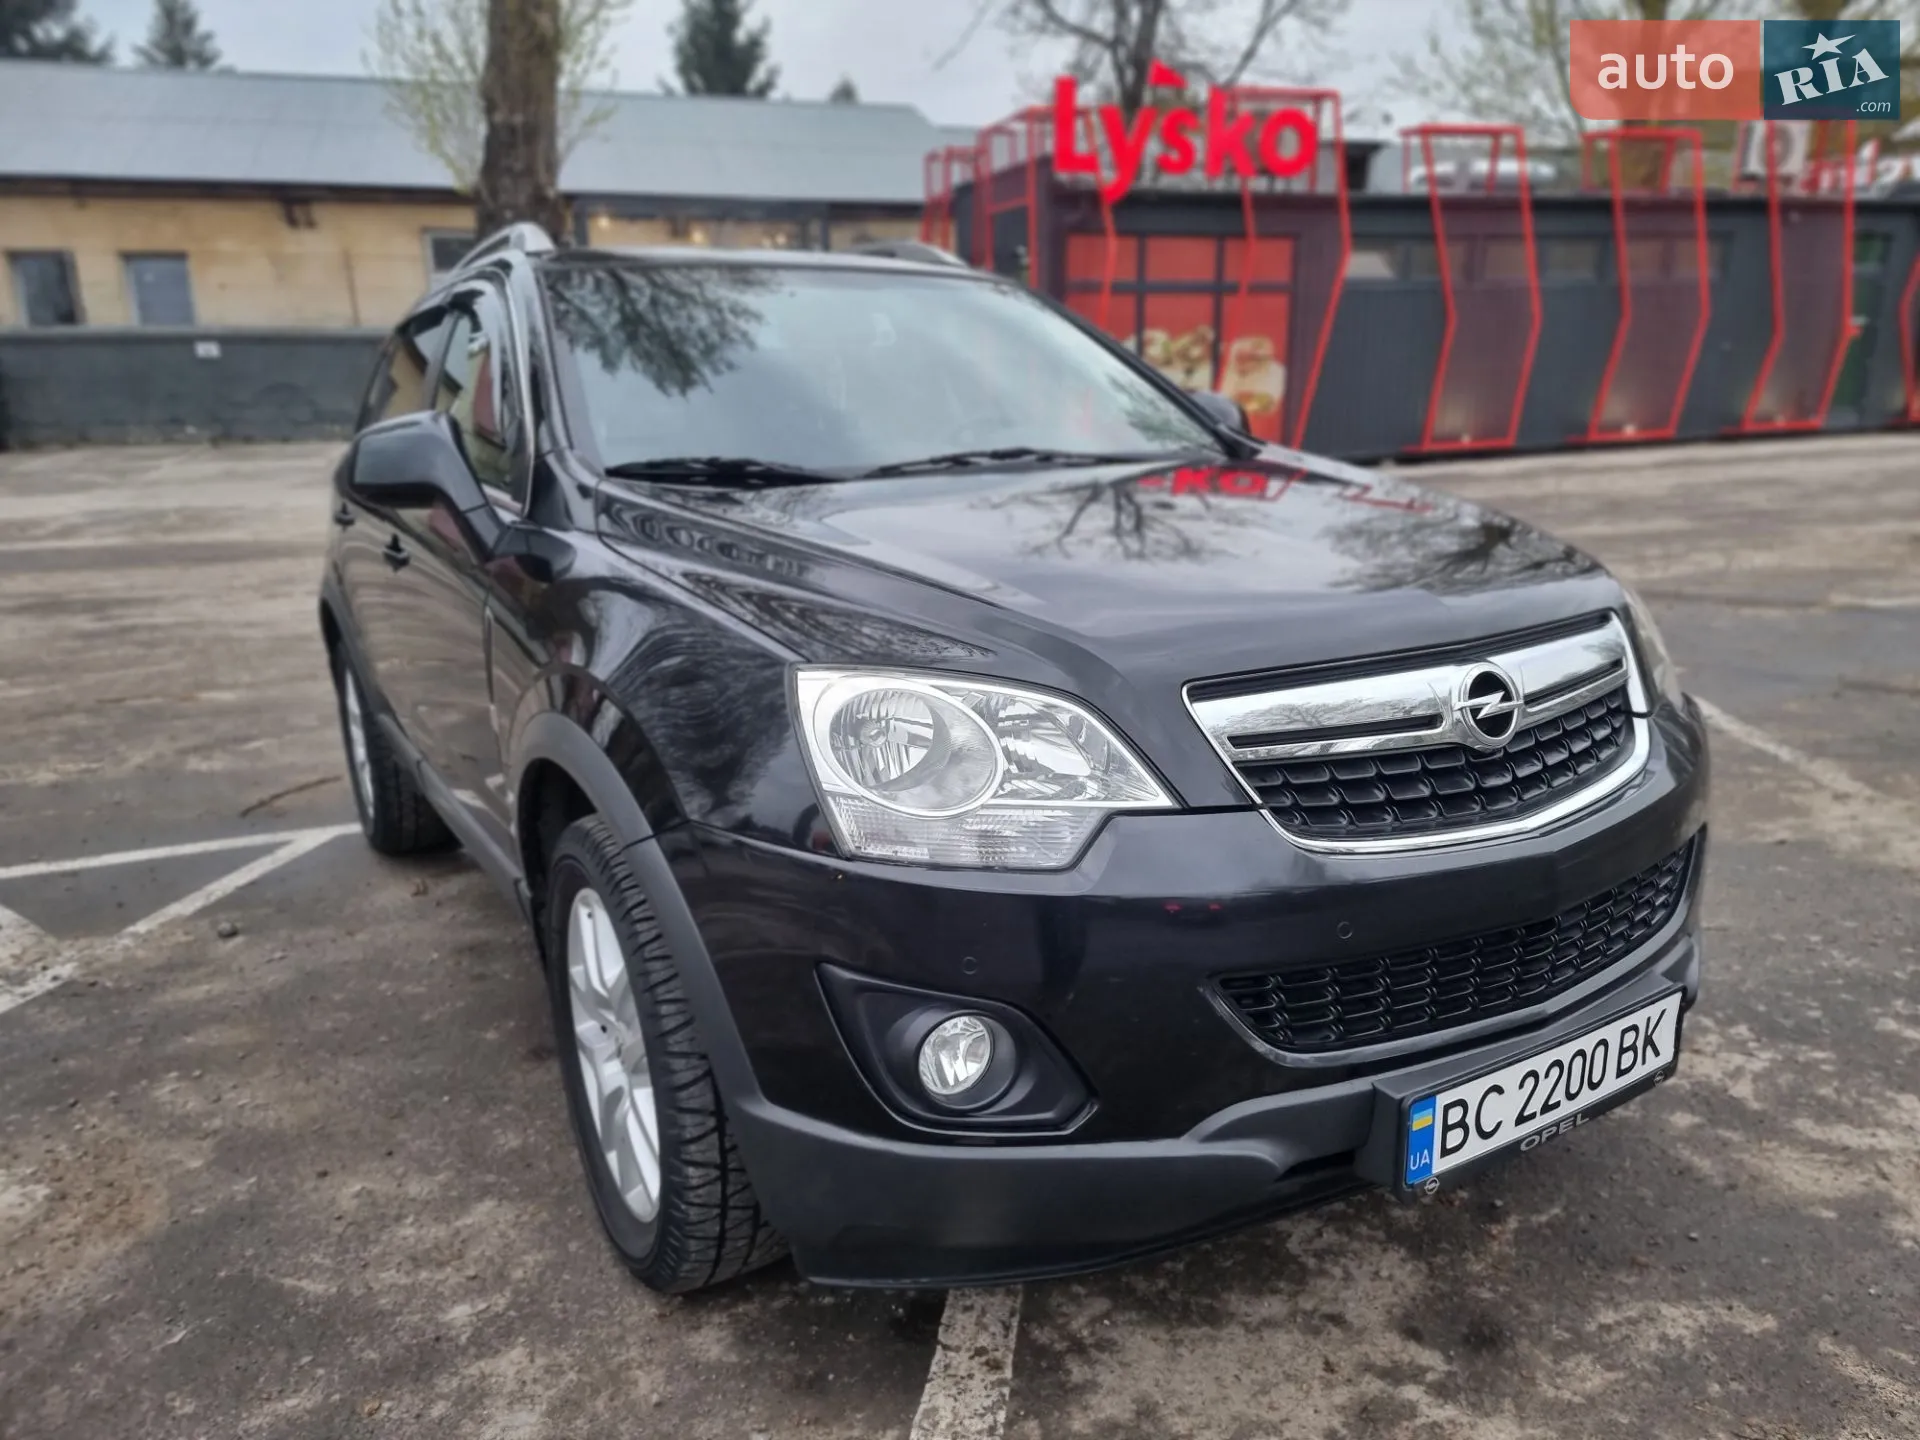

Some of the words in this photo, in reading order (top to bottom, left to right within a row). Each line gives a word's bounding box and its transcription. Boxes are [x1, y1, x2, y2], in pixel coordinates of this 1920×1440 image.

[1053, 74, 1318, 205] Lysko
[1439, 1084, 1505, 1159] BC
[1514, 1038, 1609, 1127] 2200
[1615, 1008, 1667, 1080] BK
[1409, 1148, 1431, 1170] UA
[1519, 1113, 1590, 1151] OPEL
